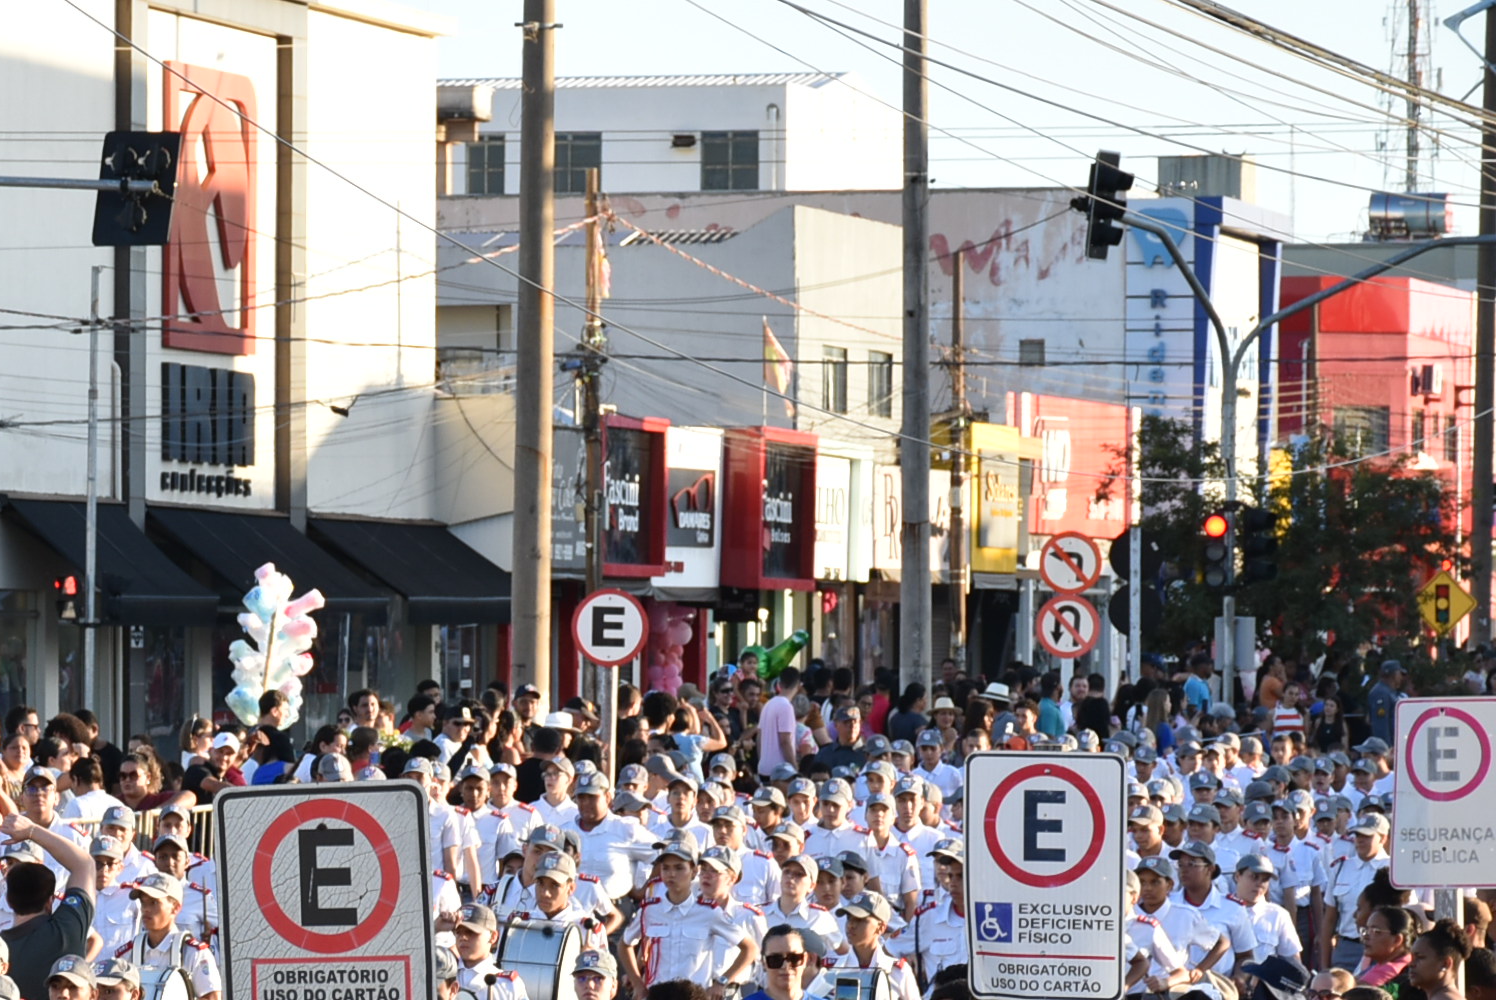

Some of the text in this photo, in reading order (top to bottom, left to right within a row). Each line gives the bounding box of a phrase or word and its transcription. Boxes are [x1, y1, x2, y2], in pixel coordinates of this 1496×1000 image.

[160, 362, 255, 467] IRIA
[592, 606, 625, 647] E
[1427, 726, 1460, 782] E
[1023, 789, 1067, 862] E
[1400, 827, 1495, 845] SEGURANÇA
[1412, 847, 1480, 864] PÚBLICA
[298, 828, 358, 926] E
[1018, 903, 1112, 916] EXCLUSIVO
[1018, 917, 1115, 931] DEFICIENTE
[1018, 930, 1072, 944] FÍSICO
[273, 965, 389, 985] OBRIGATÓRIO
[998, 961, 1092, 977] OBRIGATÓRIO
[991, 977, 1101, 993] USO DO CARTÃO
